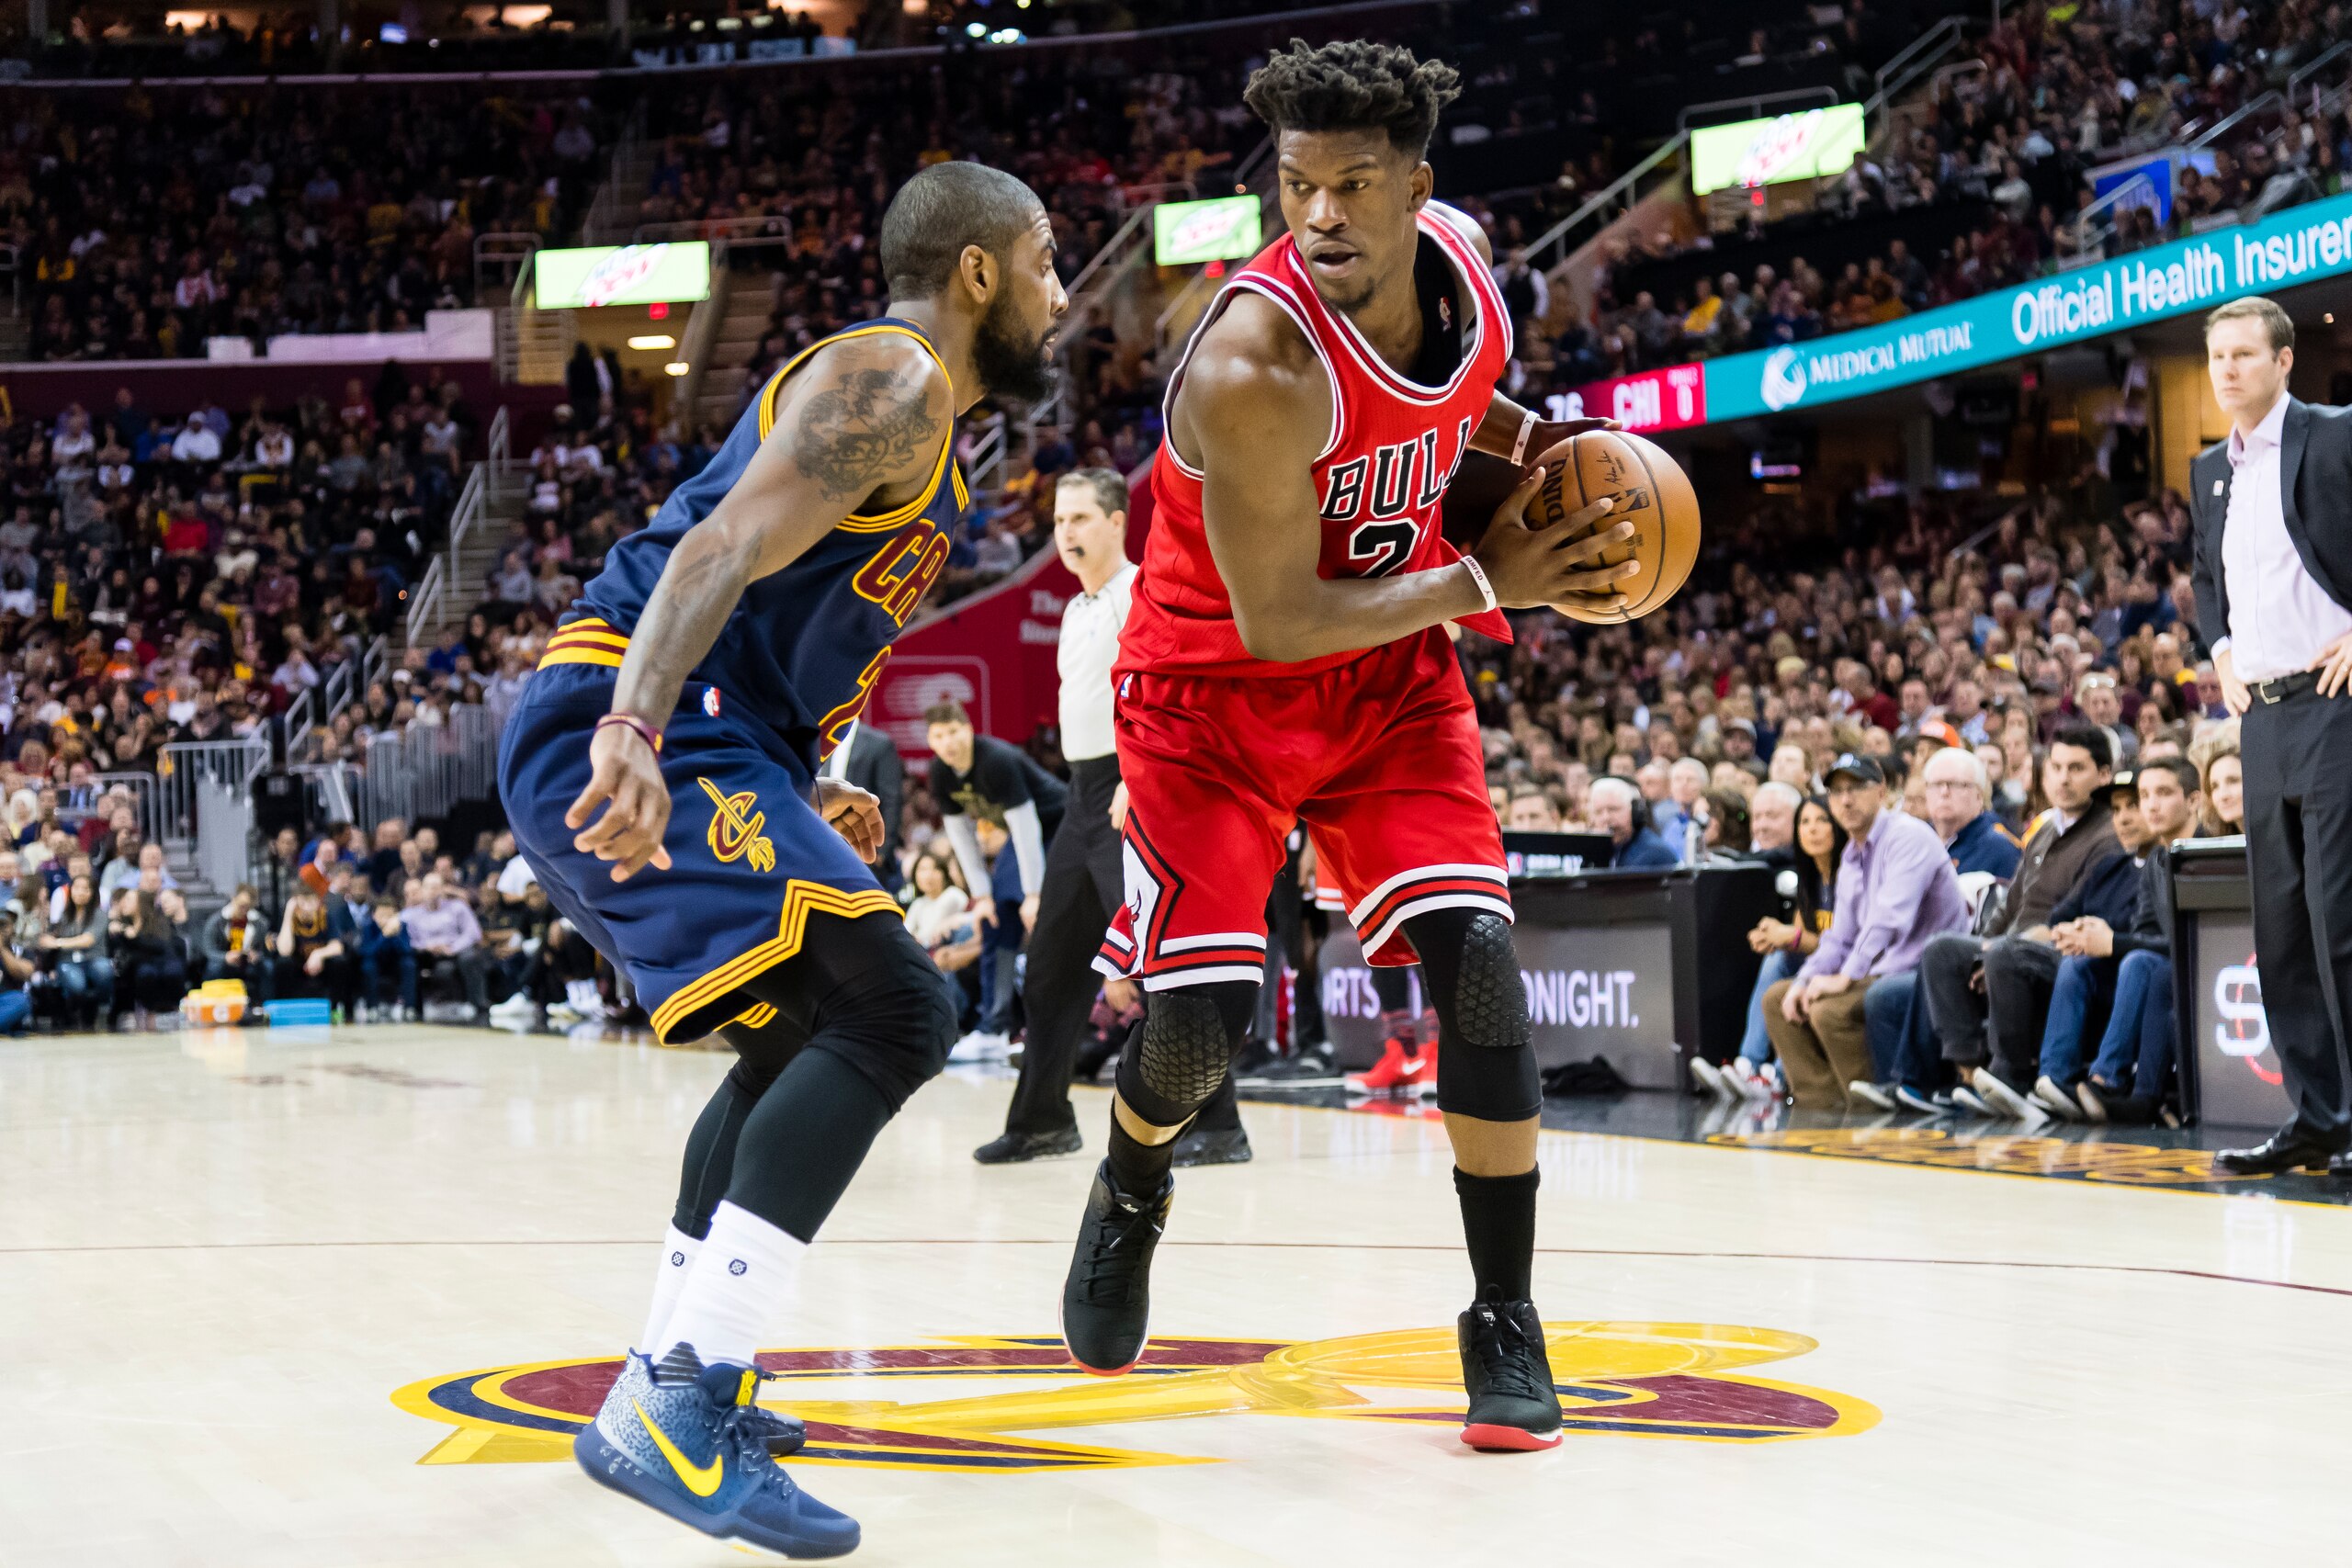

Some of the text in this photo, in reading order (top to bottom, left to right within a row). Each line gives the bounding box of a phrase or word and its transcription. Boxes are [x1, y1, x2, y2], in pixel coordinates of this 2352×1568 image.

[2012, 205, 2352, 345] Official Health Insurer
[1809, 321, 1973, 385] MEDICAL MUTUAL
[1612, 378, 1661, 432] CHI
[1348, 516, 1424, 578] 2
